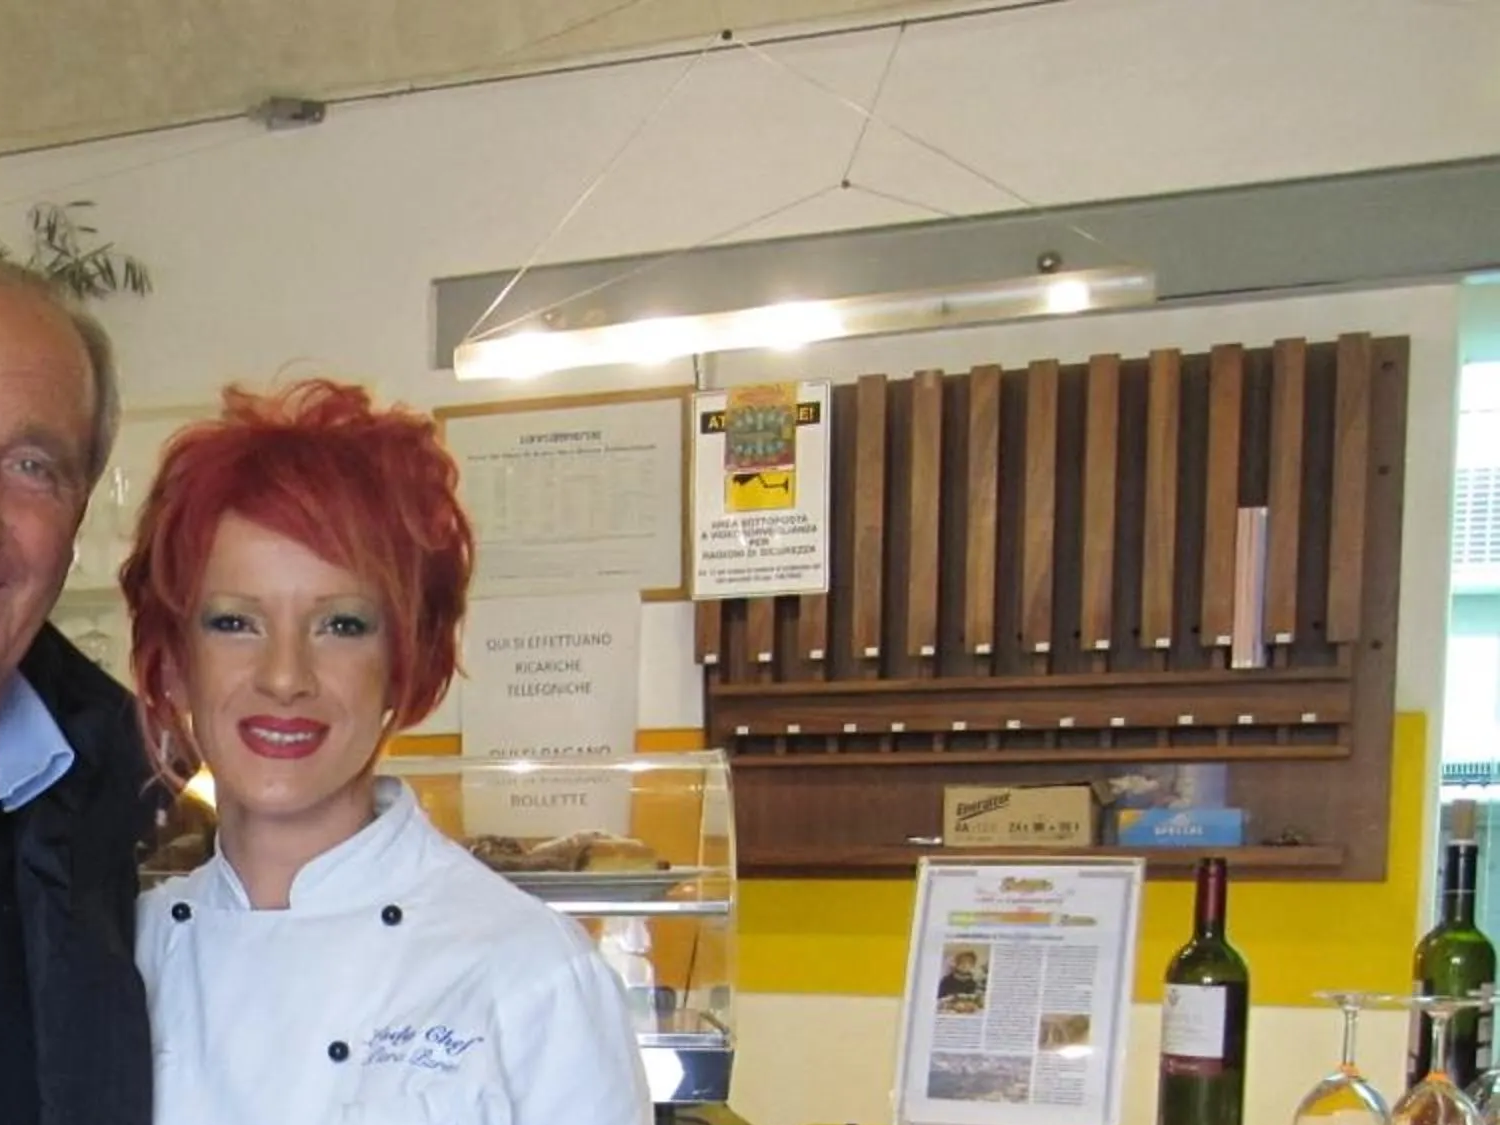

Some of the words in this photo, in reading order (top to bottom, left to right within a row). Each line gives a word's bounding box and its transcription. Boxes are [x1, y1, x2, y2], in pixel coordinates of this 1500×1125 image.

[527, 632, 613, 649] EFFETTUANO
[514, 658, 582, 674] RICARICHE
[507, 681, 592, 697] TELEFONICHE
[510, 793, 588, 808] BOLLETTE
[424, 1025, 485, 1056] Chef
